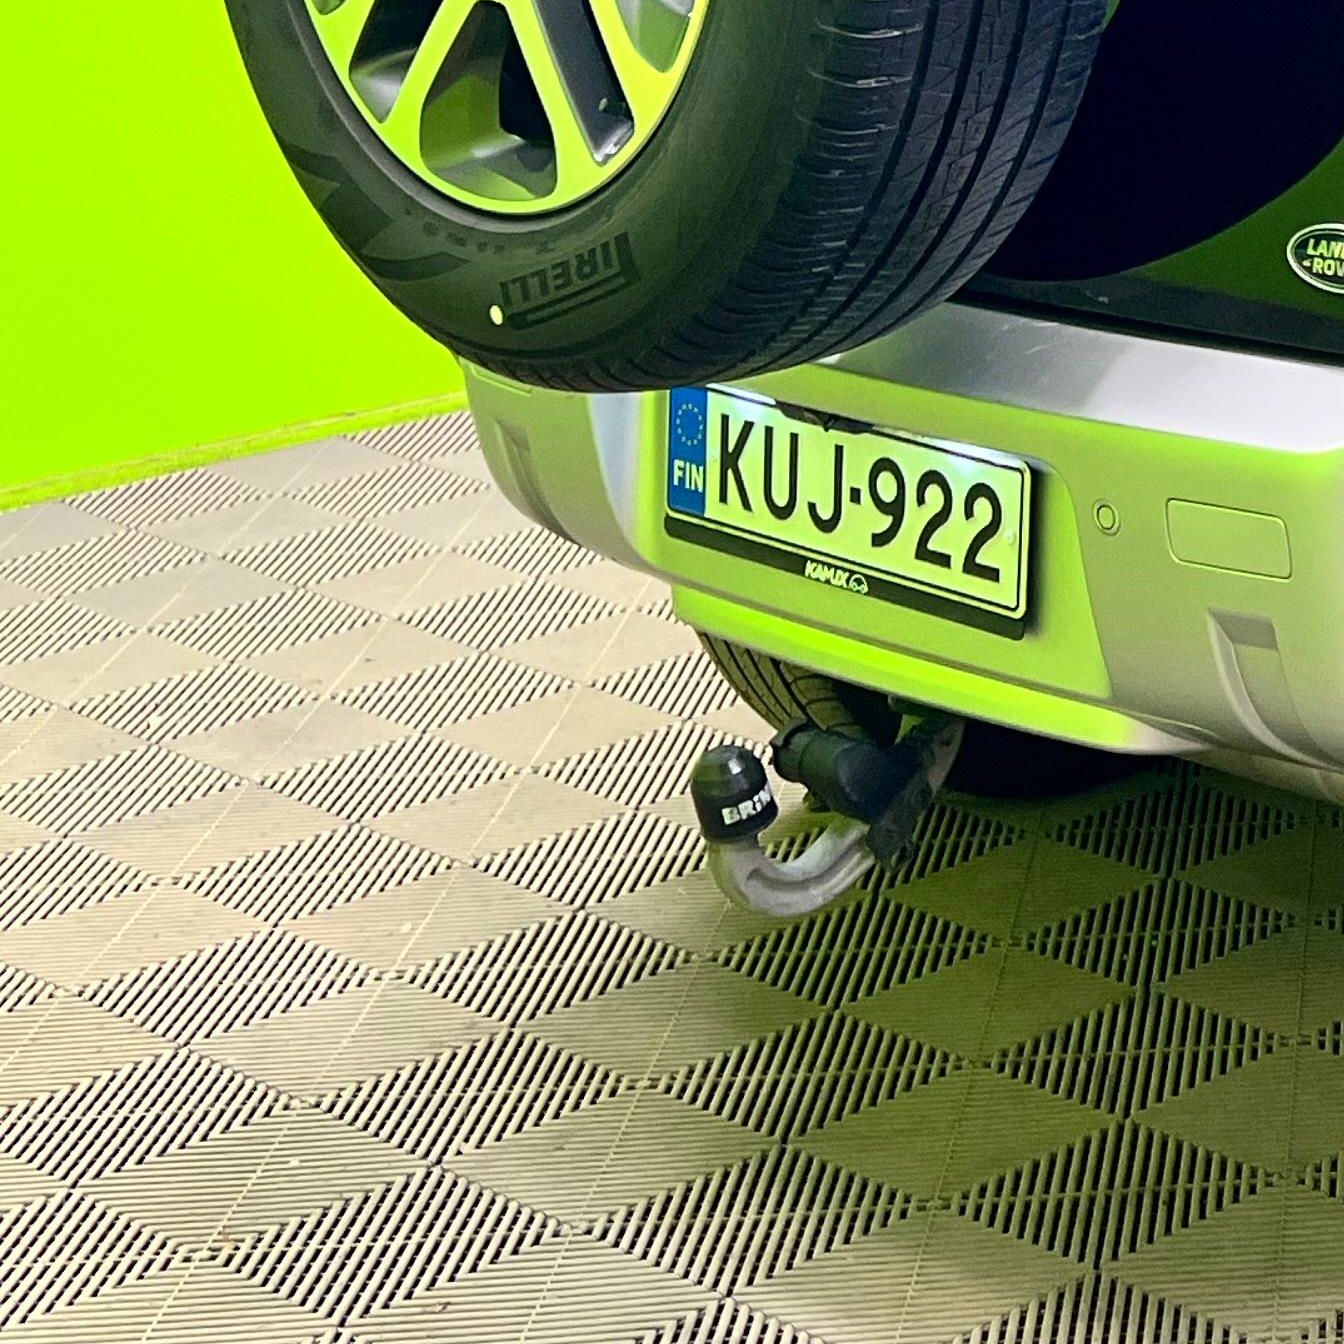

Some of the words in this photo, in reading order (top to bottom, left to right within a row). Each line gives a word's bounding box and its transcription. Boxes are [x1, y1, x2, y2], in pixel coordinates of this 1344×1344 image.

[499, 230, 642, 332] PIRELLI
[672, 459, 704, 493] FIN
[718, 413, 1001, 584] KUJ-922
